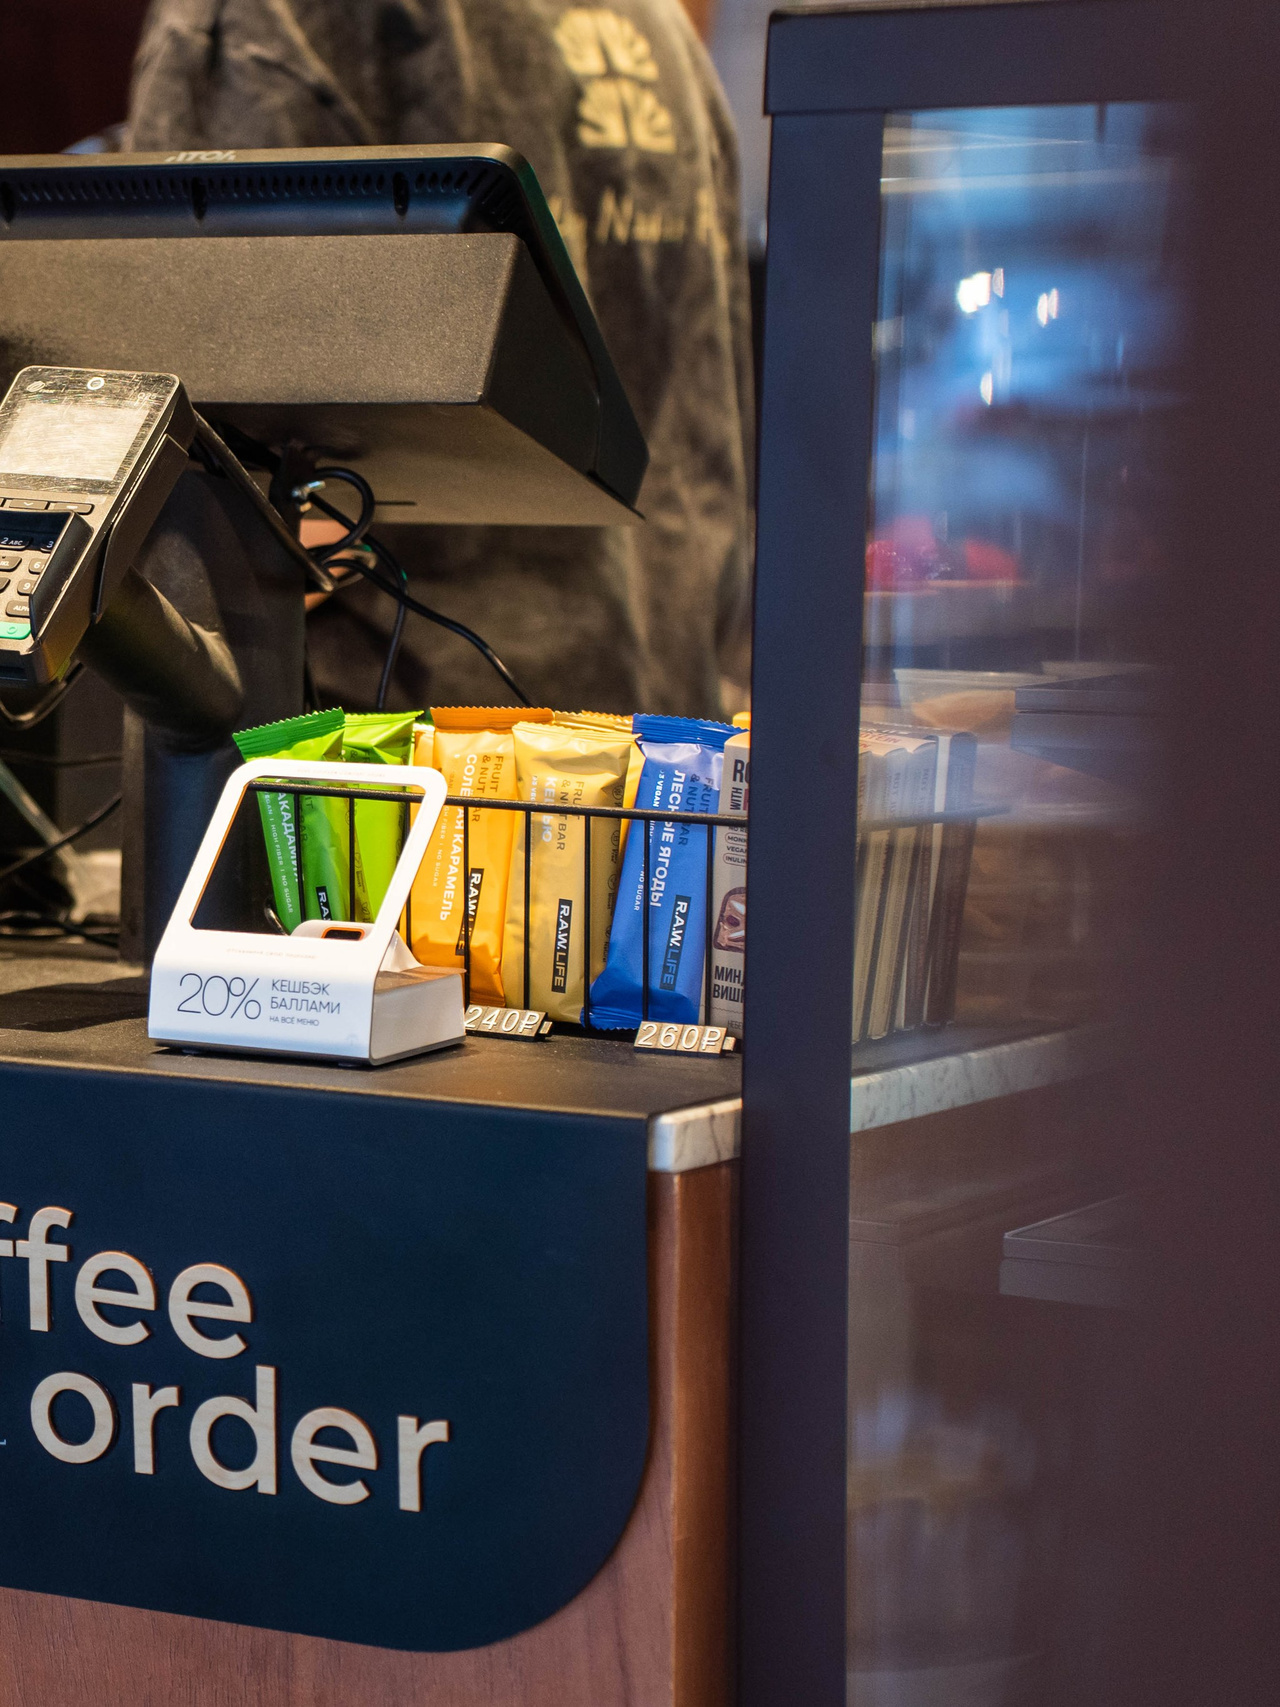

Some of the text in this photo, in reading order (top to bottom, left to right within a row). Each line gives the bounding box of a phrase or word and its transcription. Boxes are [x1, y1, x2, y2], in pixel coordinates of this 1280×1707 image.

[455, 754, 478, 830] СОЛЁАЯ
[557, 824, 567, 851] BAR
[554, 904, 570, 987] R.A.W. LIFE
[177, 973, 262, 1020] 20%
[271, 979, 331, 996] КЕШБЭК
[271, 997, 340, 1015] БАЛЛАМИ
[297, 1017, 320, 1026] МЕНЮ
[30, 1365, 449, 1512] order
